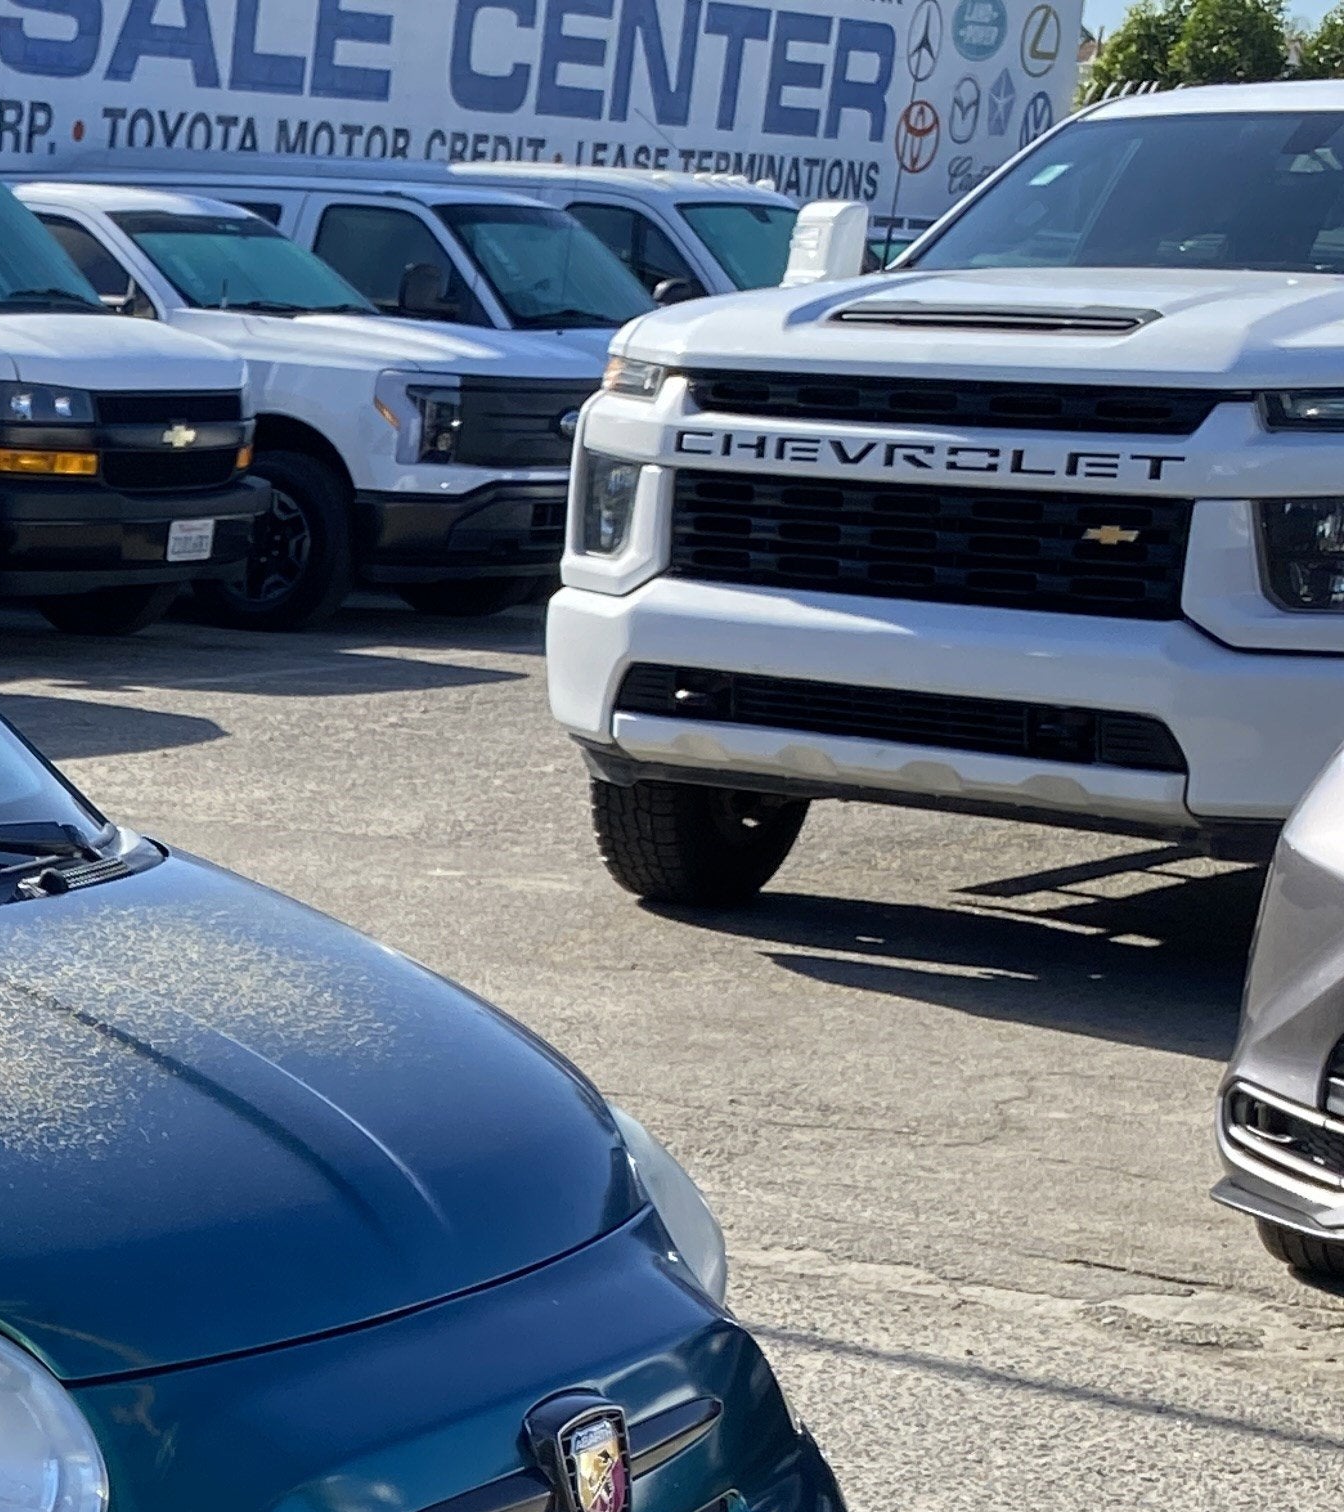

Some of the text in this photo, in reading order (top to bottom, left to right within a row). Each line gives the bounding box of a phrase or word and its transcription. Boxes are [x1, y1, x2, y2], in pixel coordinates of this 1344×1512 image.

[450, 0, 896, 142] CENTER
[102, 107, 258, 152] TOYOTA
[275, 118, 410, 159] MOTOR
[424, 129, 546, 162] CREDIT
[679, 149, 880, 201] TERMINATIONS
[674, 430, 1186, 480] CHEVROLET
